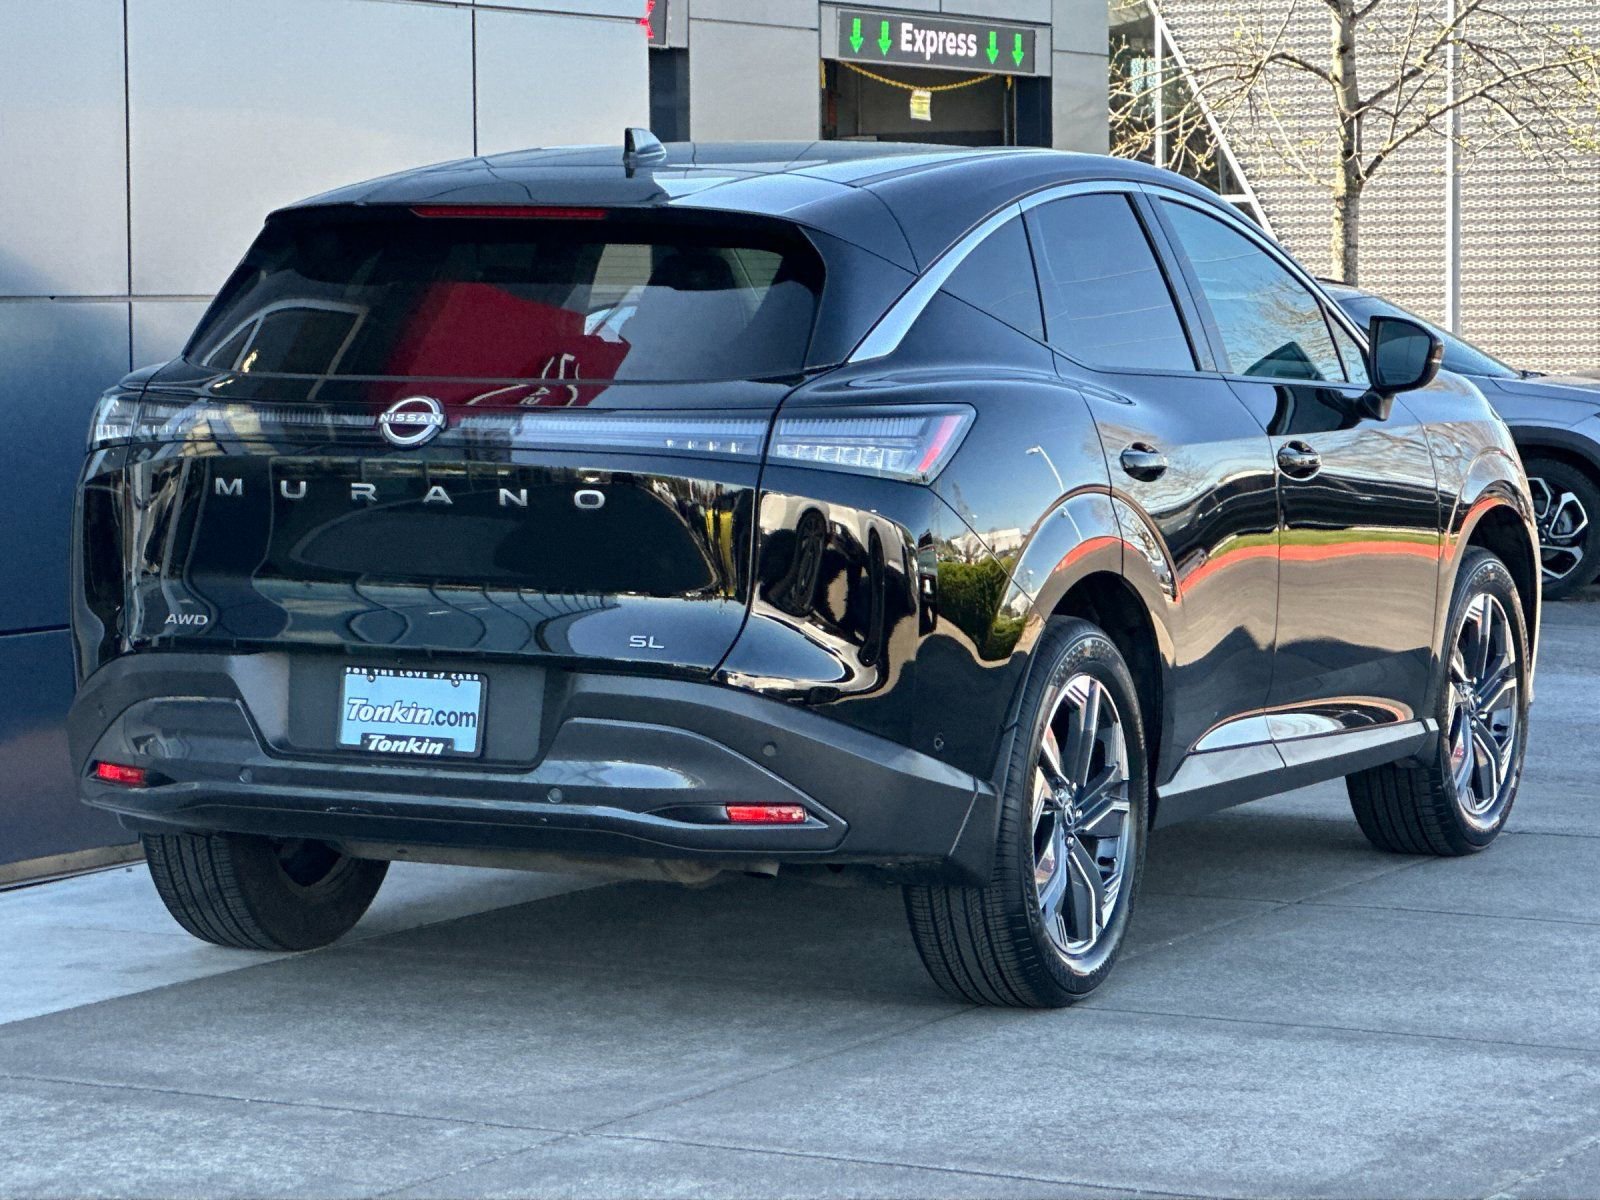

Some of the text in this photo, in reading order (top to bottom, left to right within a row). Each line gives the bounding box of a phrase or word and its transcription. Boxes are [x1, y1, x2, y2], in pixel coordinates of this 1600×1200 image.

[900, 22, 978, 60] Express
[380, 413, 442, 424] NISSAN
[214, 477, 607, 510] MURANO
[164, 613, 209, 626] AWD
[629, 635, 665, 649] SL
[399, 670, 428, 678] LOVE
[450, 673, 480, 681] CARS
[347, 697, 476, 727] Tonkin.com
[368, 735, 444, 755] Tonkin
